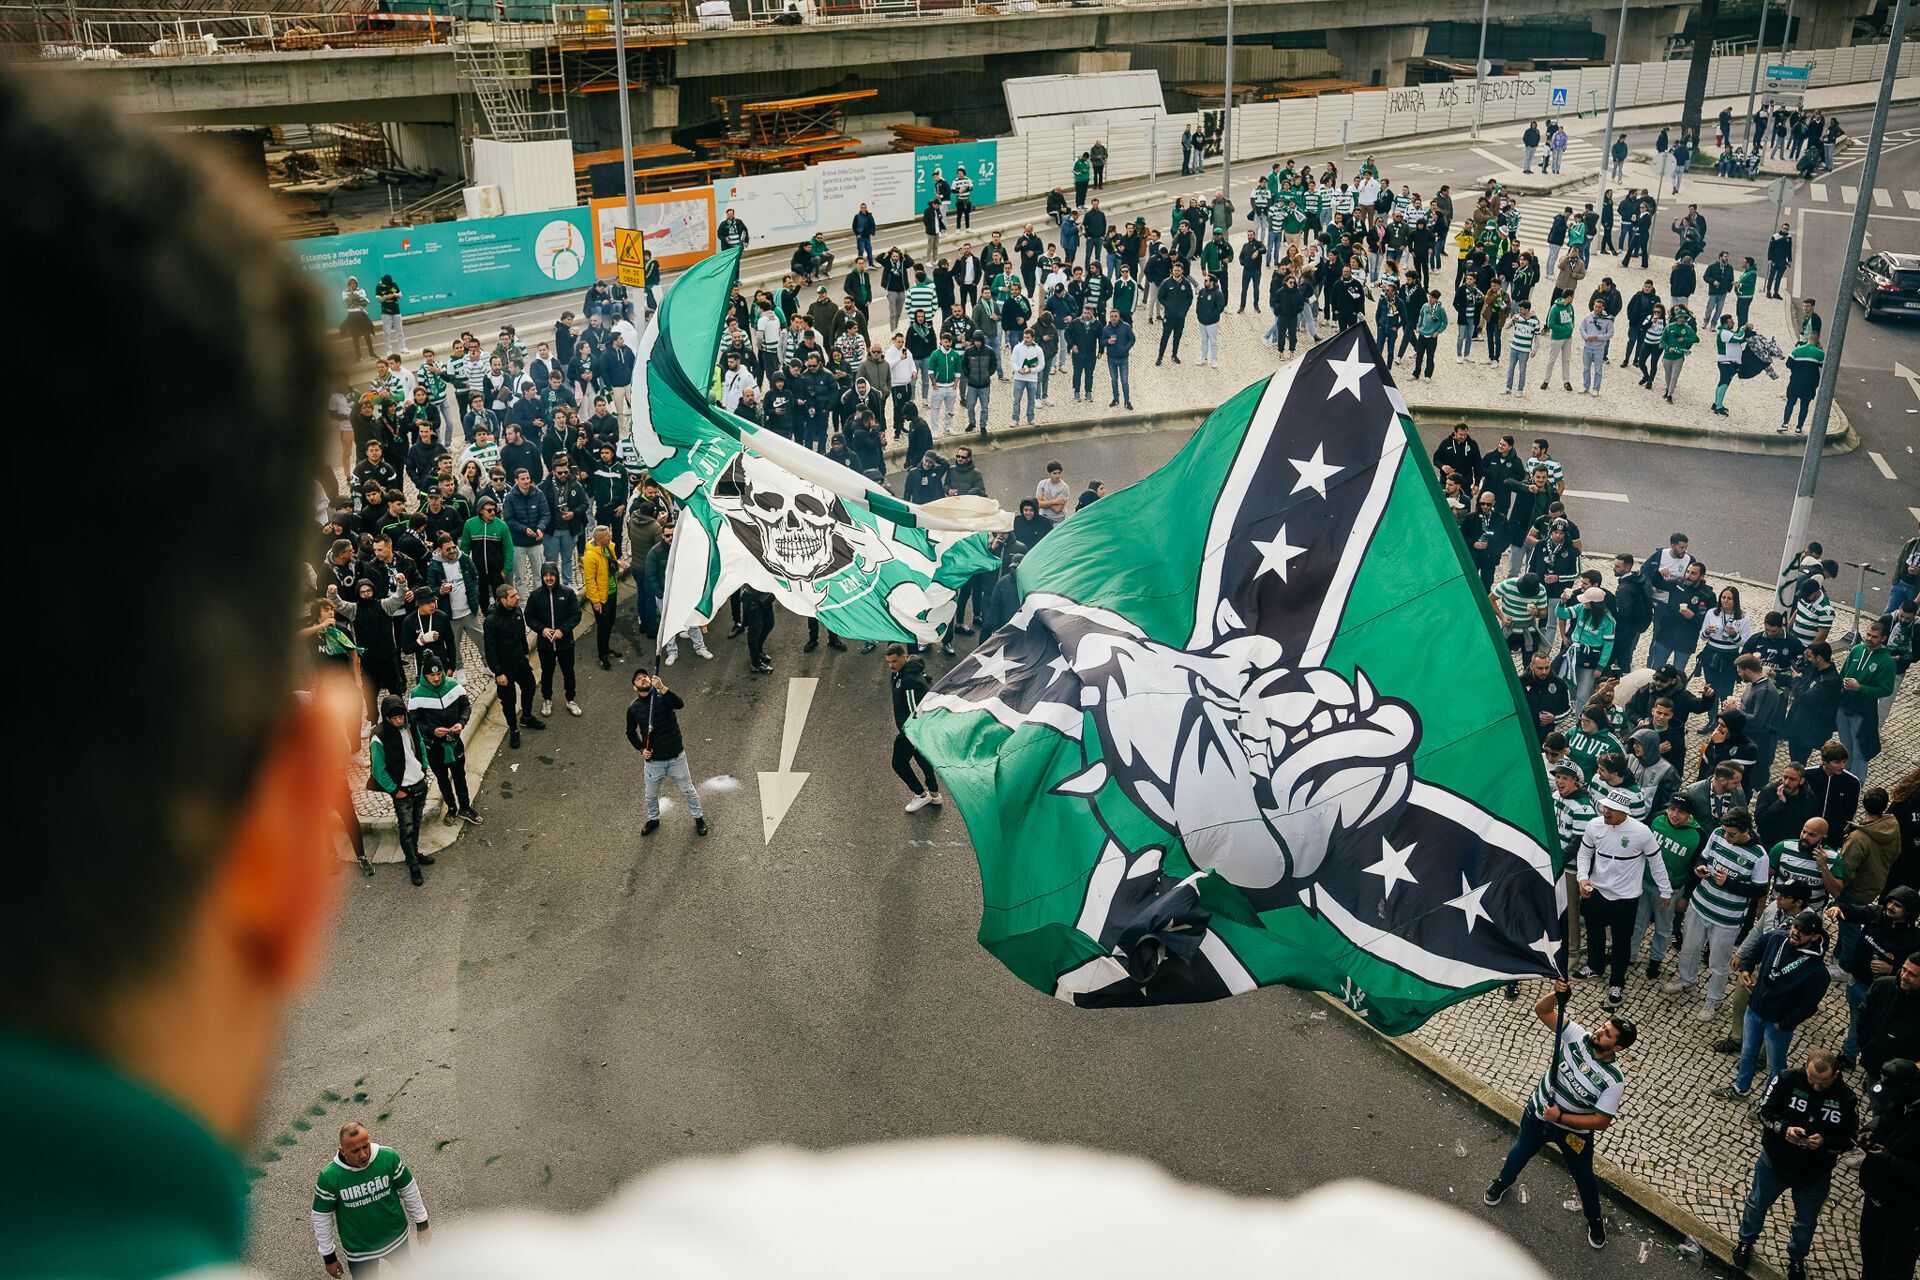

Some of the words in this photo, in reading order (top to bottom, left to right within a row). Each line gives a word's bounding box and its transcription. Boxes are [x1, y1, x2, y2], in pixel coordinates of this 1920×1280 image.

[1389, 90, 1426, 114] HONRA
[1437, 86, 1459, 108] AOS
[917, 168, 925, 184] 2
[978, 161, 994, 178] 4,2
[300, 252, 332, 263] Estamos
[338, 248, 369, 258] melhorar
[322, 258, 362, 269] mobilidade
[1565, 1071, 1588, 1098] BETANO
[1789, 1096, 1808, 1113] 19
[1821, 1107, 1841, 1124] 76
[340, 1175, 390, 1202] DIREÇÃO
